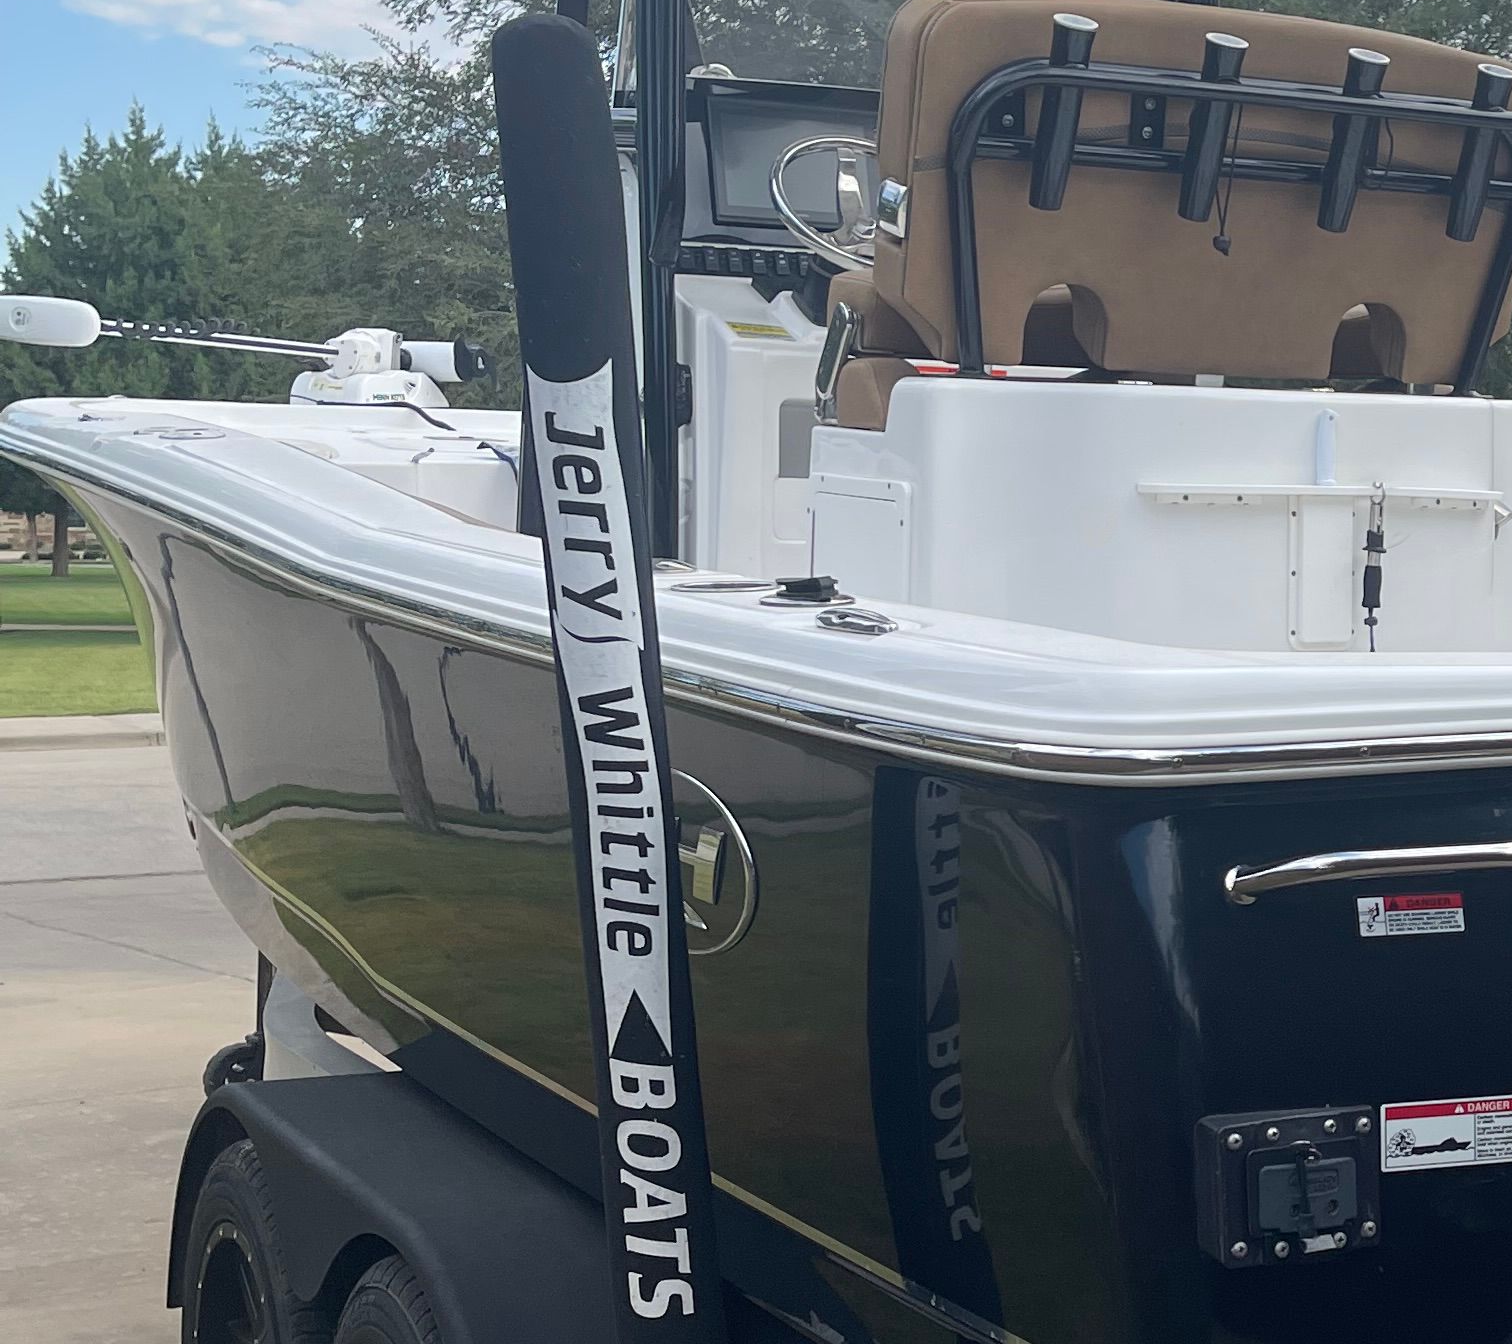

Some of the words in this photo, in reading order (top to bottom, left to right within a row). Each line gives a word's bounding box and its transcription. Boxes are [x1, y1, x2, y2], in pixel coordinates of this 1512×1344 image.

[544, 410, 624, 621] Jerry
[577, 685, 660, 957] Whittle
[608, 1057, 695, 1320] BOATS
[1467, 1100, 1510, 1112] DANGER
